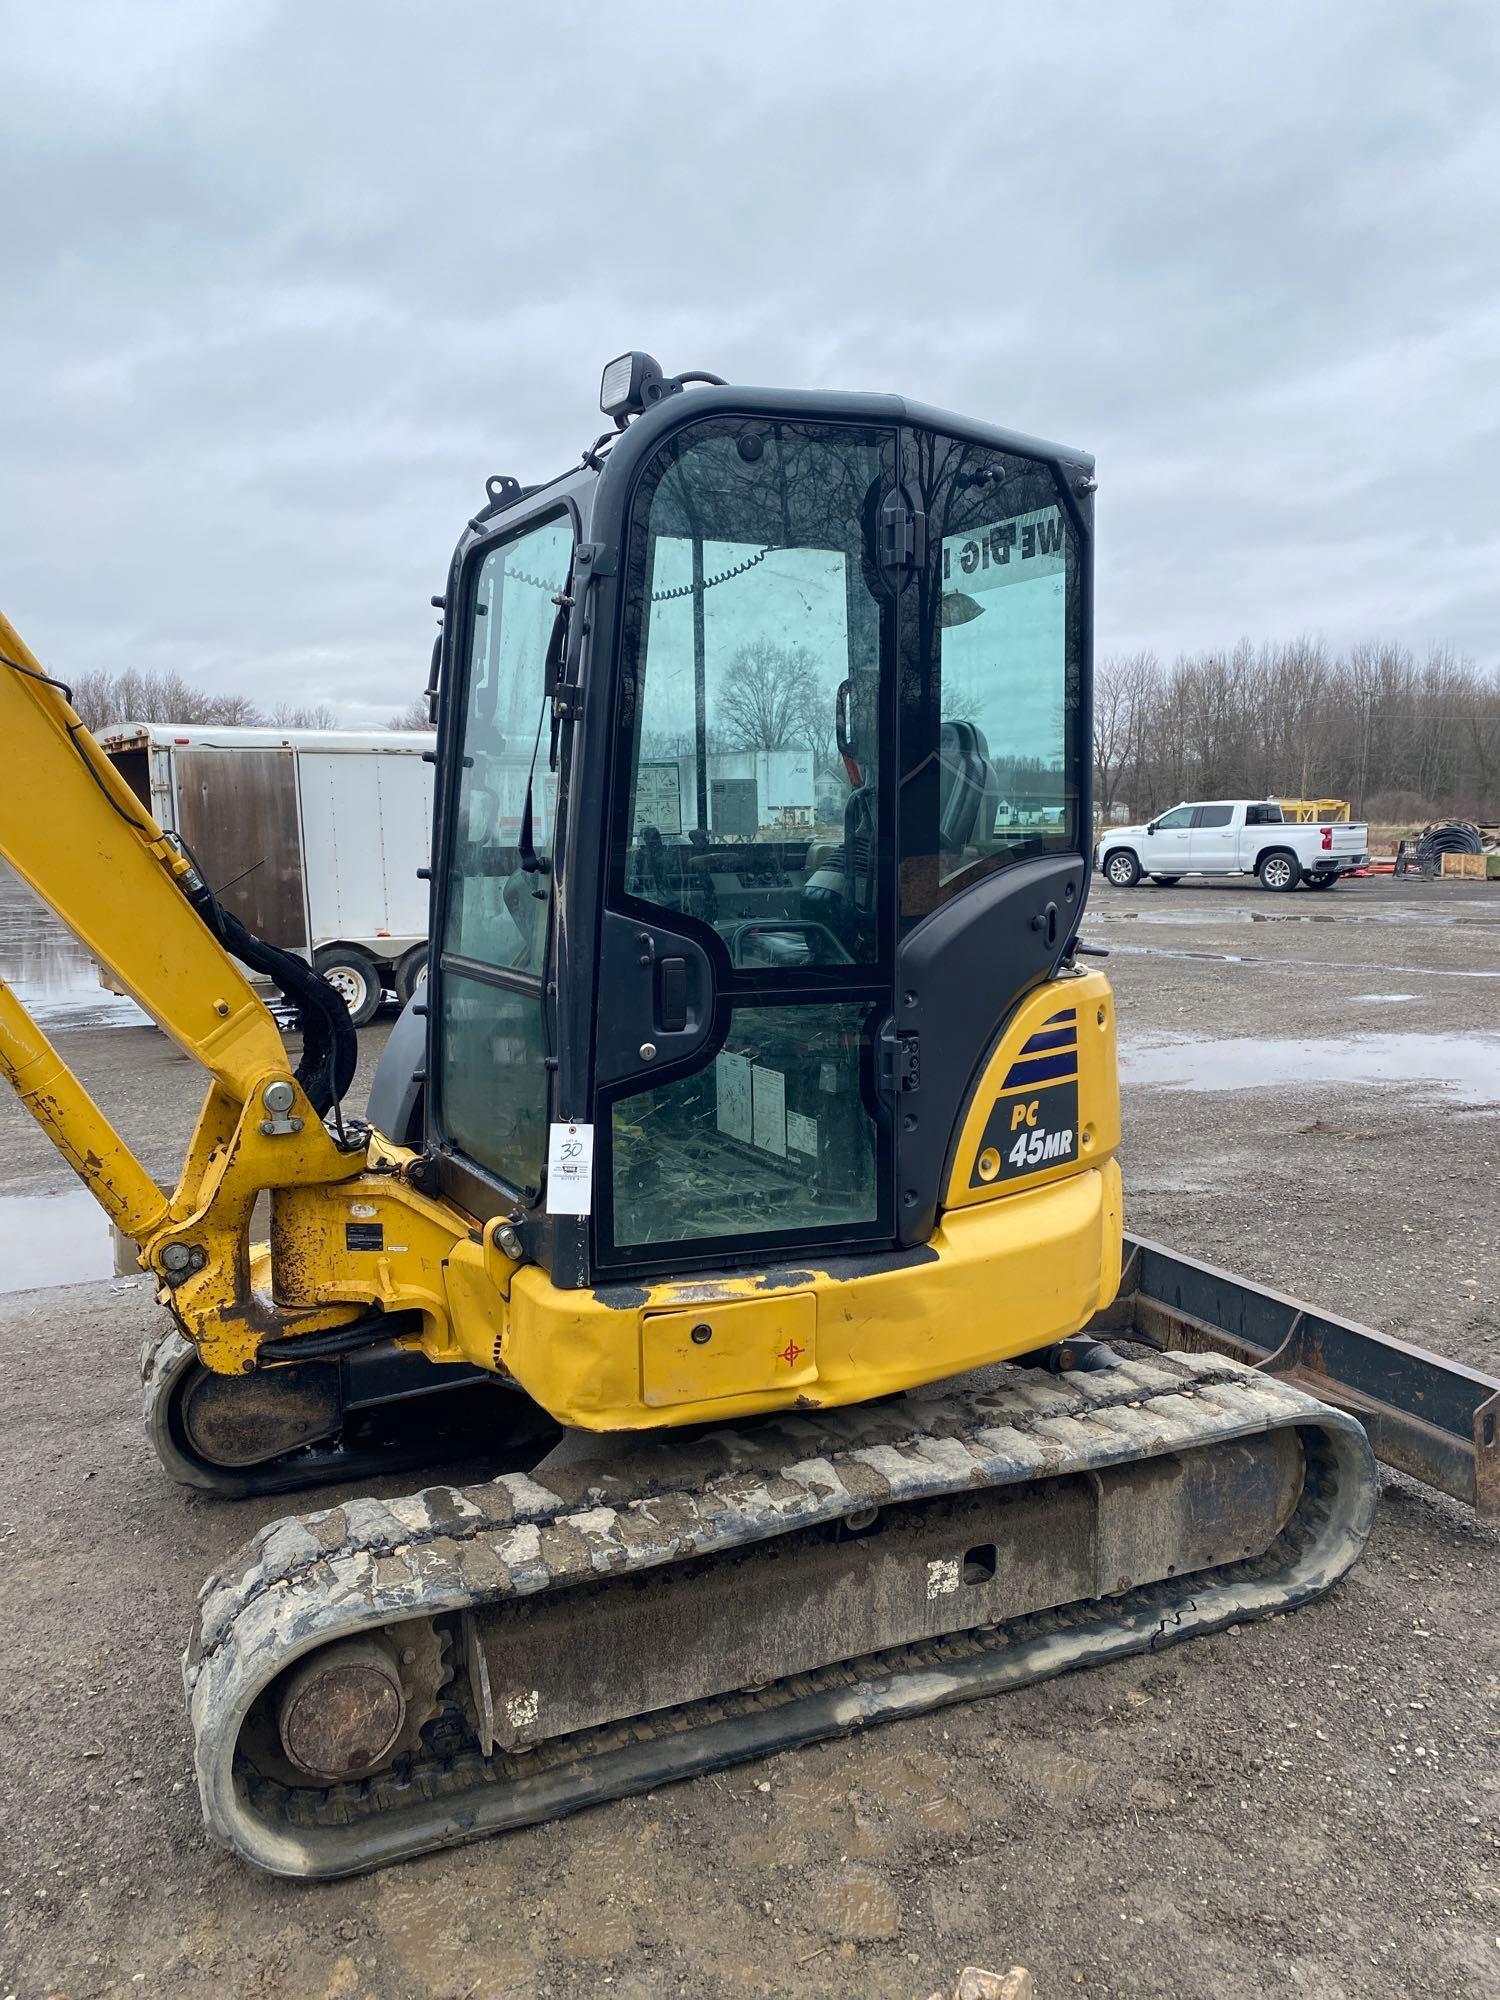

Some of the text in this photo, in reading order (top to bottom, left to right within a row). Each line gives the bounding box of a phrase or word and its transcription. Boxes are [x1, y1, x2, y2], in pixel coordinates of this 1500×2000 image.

[1011, 1100, 1040, 1131] PC
[561, 1143, 583, 1160] 30
[1008, 1128, 1073, 1167] 45MR
